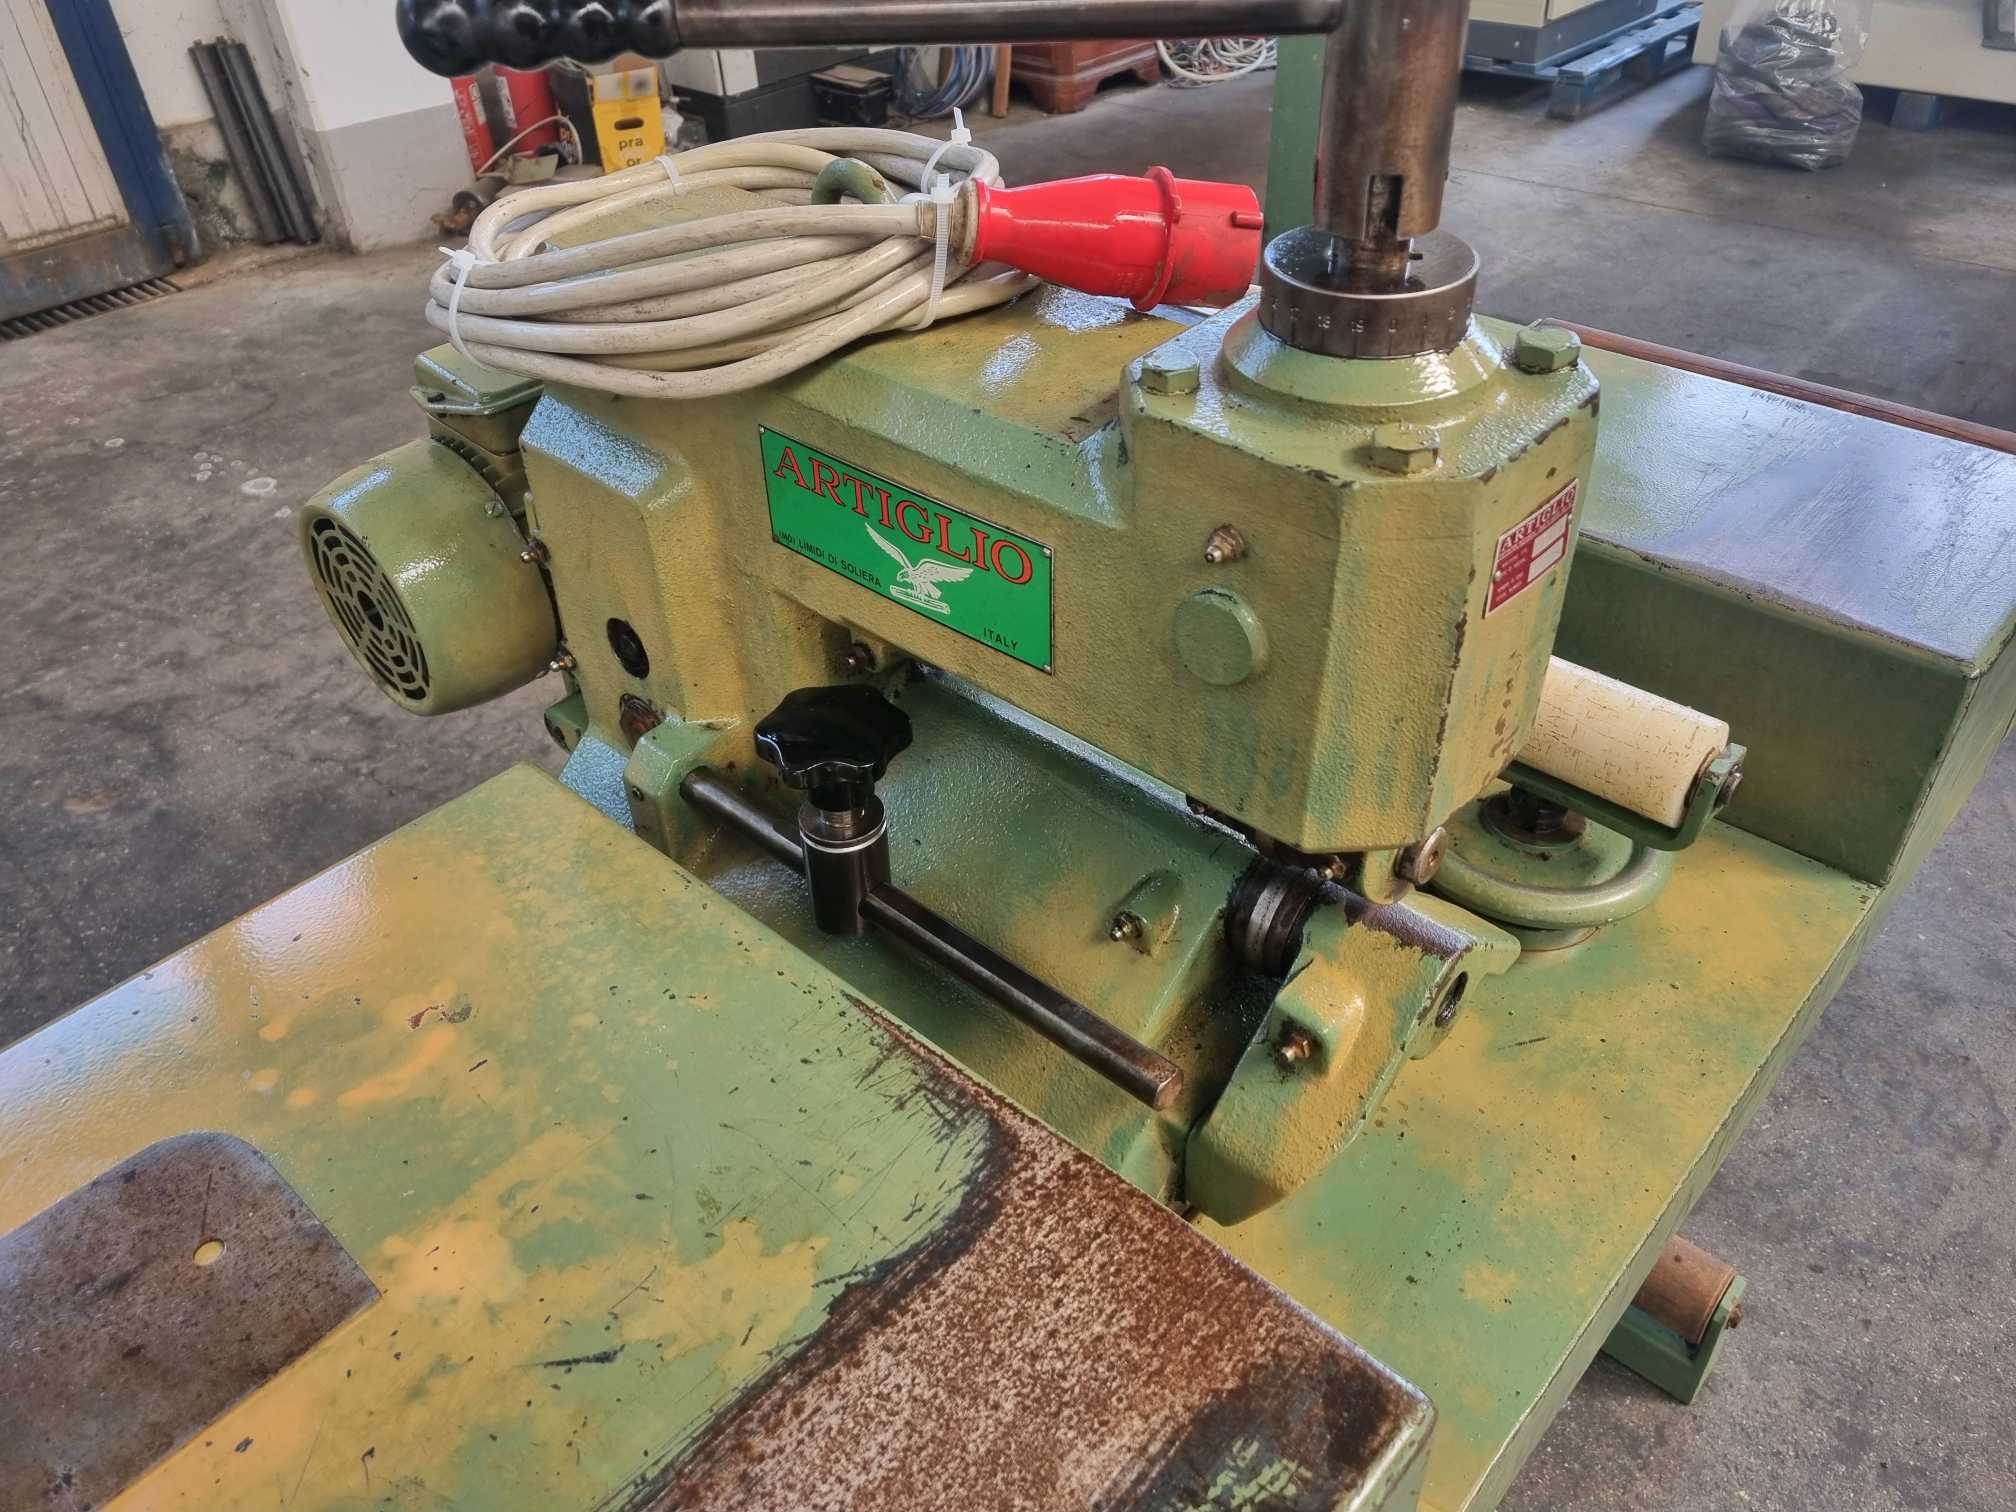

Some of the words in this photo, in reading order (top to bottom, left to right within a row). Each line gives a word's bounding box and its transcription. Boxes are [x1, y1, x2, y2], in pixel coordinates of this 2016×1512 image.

[619, 137, 644, 151] pra
[774, 446, 1033, 585] ARTIGLIO
[1502, 487, 1575, 550] ARTIGLIO
[798, 537, 825, 560] LIMIDI
[828, 551, 838, 566] DI
[840, 559, 882, 588] SOLIERA
[983, 627, 1019, 650] ITALY
